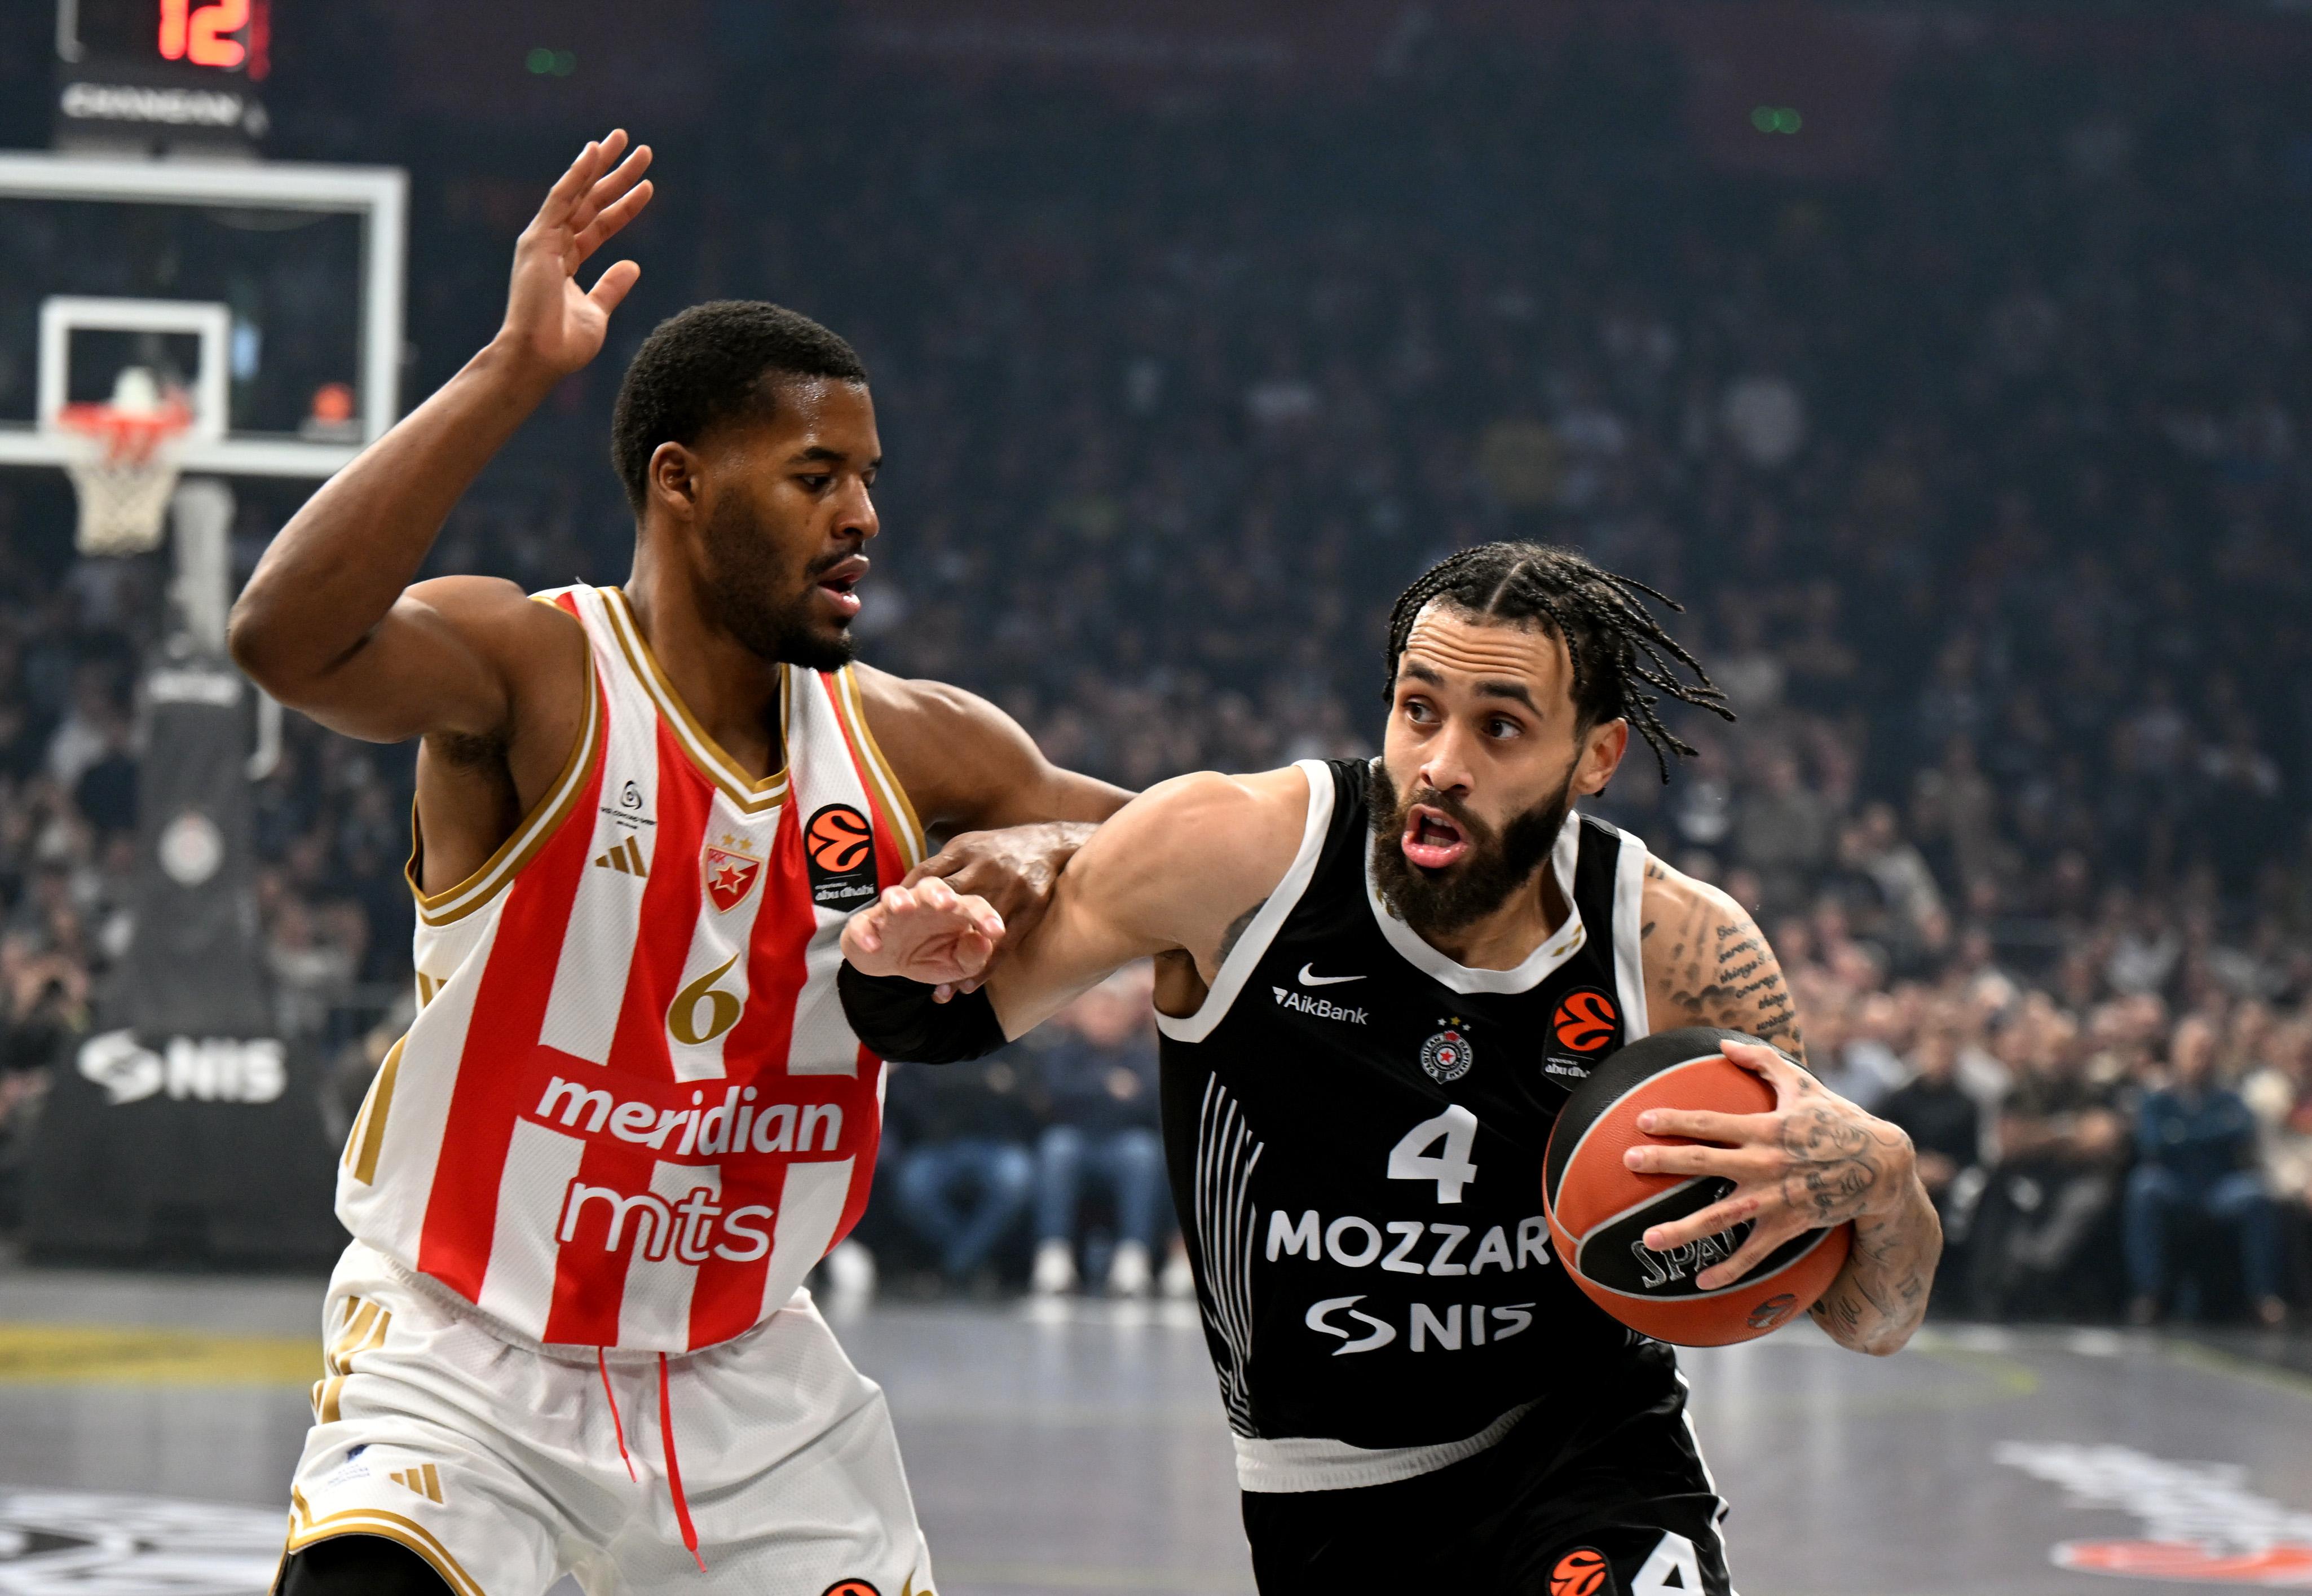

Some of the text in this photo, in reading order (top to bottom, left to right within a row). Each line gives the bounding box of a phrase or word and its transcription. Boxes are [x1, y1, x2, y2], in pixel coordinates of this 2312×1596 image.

[159, 0, 250, 67] 12
[668, 951, 740, 1045] 6
[1283, 992, 1371, 1025] AikBank
[535, 1075, 844, 1156] meridian
[1387, 1104, 1478, 1204] 4
[560, 1181, 775, 1263] mts
[1265, 1210, 1551, 1276] MOZZAR
[1410, 1303, 1537, 1353] NIS
[1631, 1530, 1706, 1596] 4
